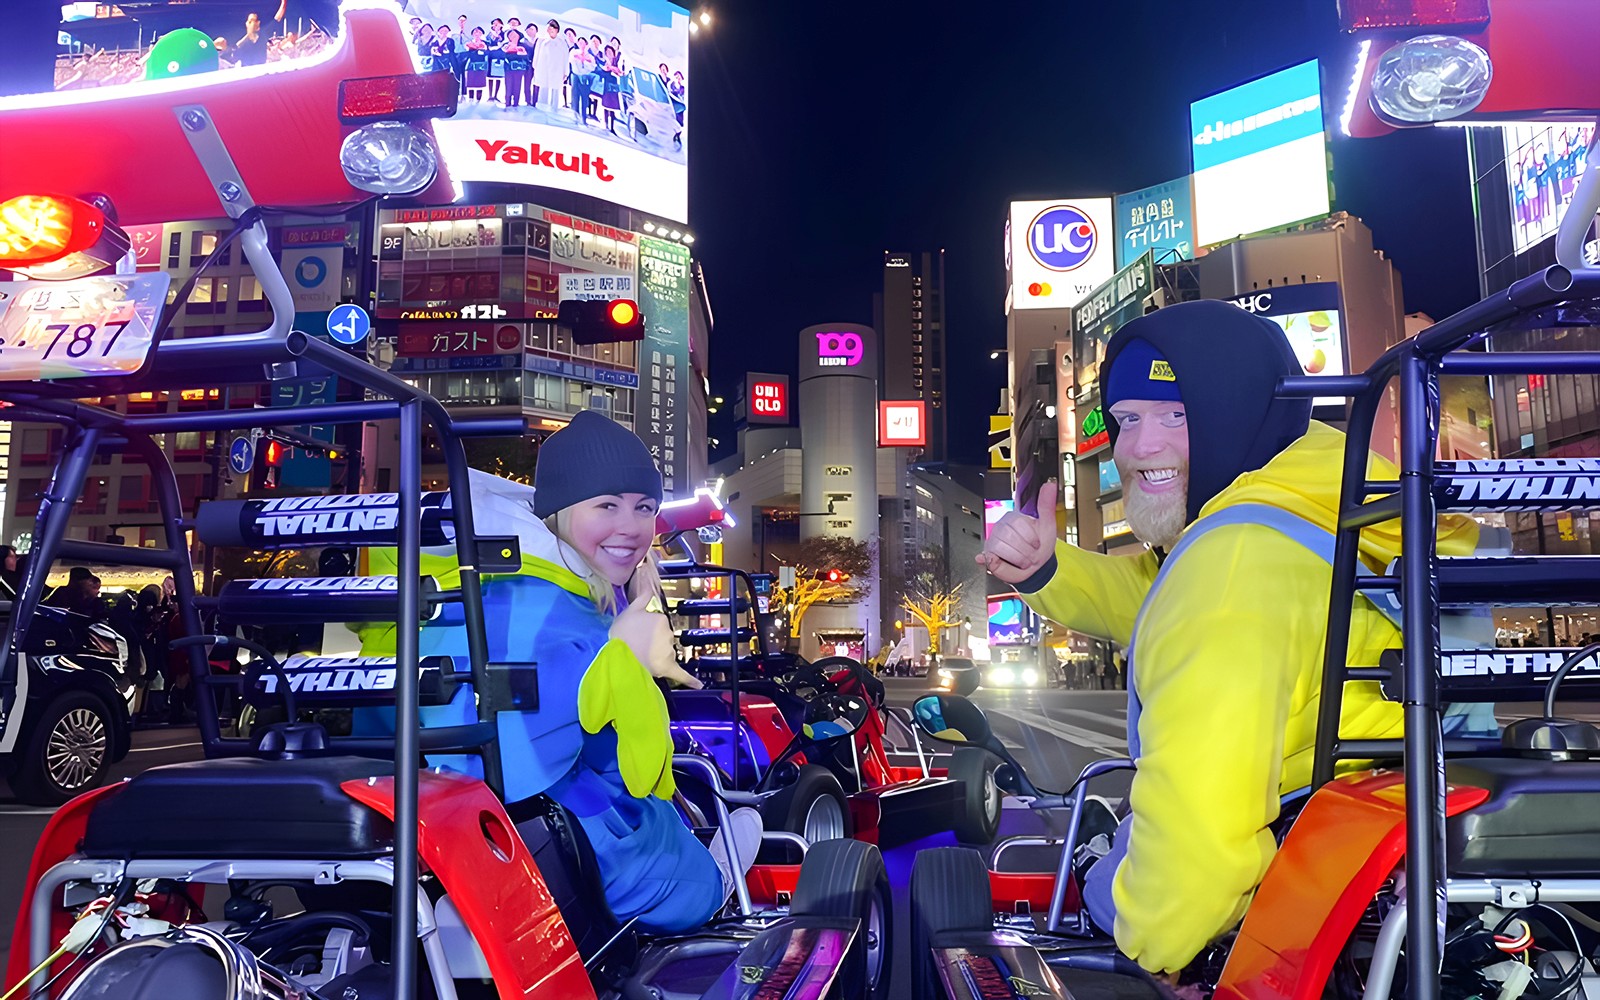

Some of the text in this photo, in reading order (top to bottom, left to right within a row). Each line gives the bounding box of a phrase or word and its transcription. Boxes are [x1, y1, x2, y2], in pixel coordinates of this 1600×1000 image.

[475, 139, 614, 182] Yakult
[383, 237, 401, 249] 9F
[1035, 222, 1093, 254] UC
[460, 304, 507, 319] ガスト
[42, 320, 130, 360] 787
[432, 331, 488, 352] ガスト
[815, 332, 864, 367] 109
[255, 507, 399, 536] ENTHAL
[259, 668, 398, 694] ENTHAL
